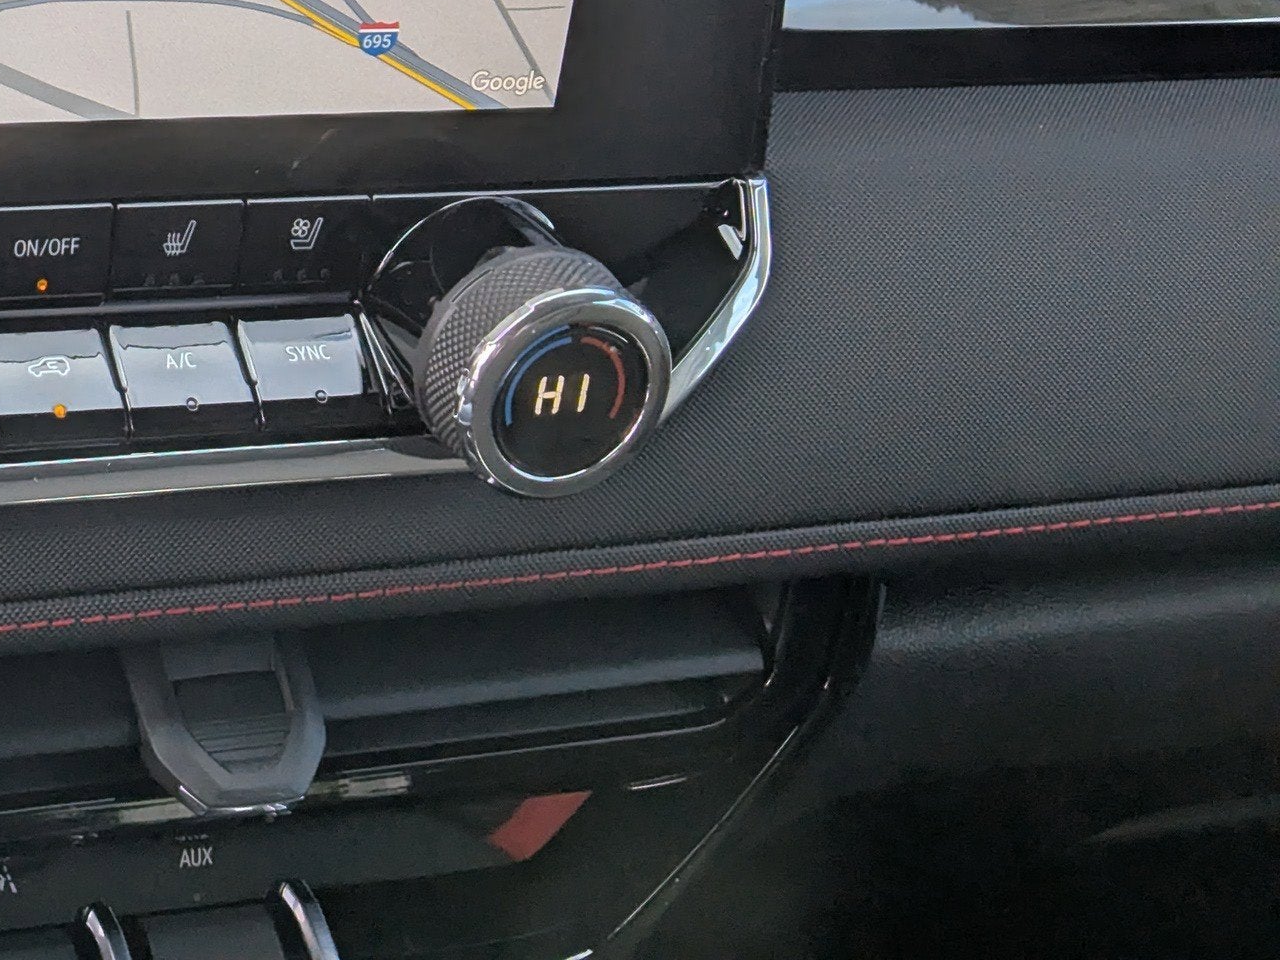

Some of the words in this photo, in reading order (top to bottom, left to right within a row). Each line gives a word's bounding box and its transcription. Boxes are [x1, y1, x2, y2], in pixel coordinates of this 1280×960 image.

[363, 34, 392, 49] 695
[471, 70, 546, 95] Google
[14, 238, 80, 257] ON/OFF
[166, 352, 197, 369] A/C
[285, 344, 331, 362] SYNC
[534, 373, 591, 415] HI
[180, 846, 213, 868] AUX
